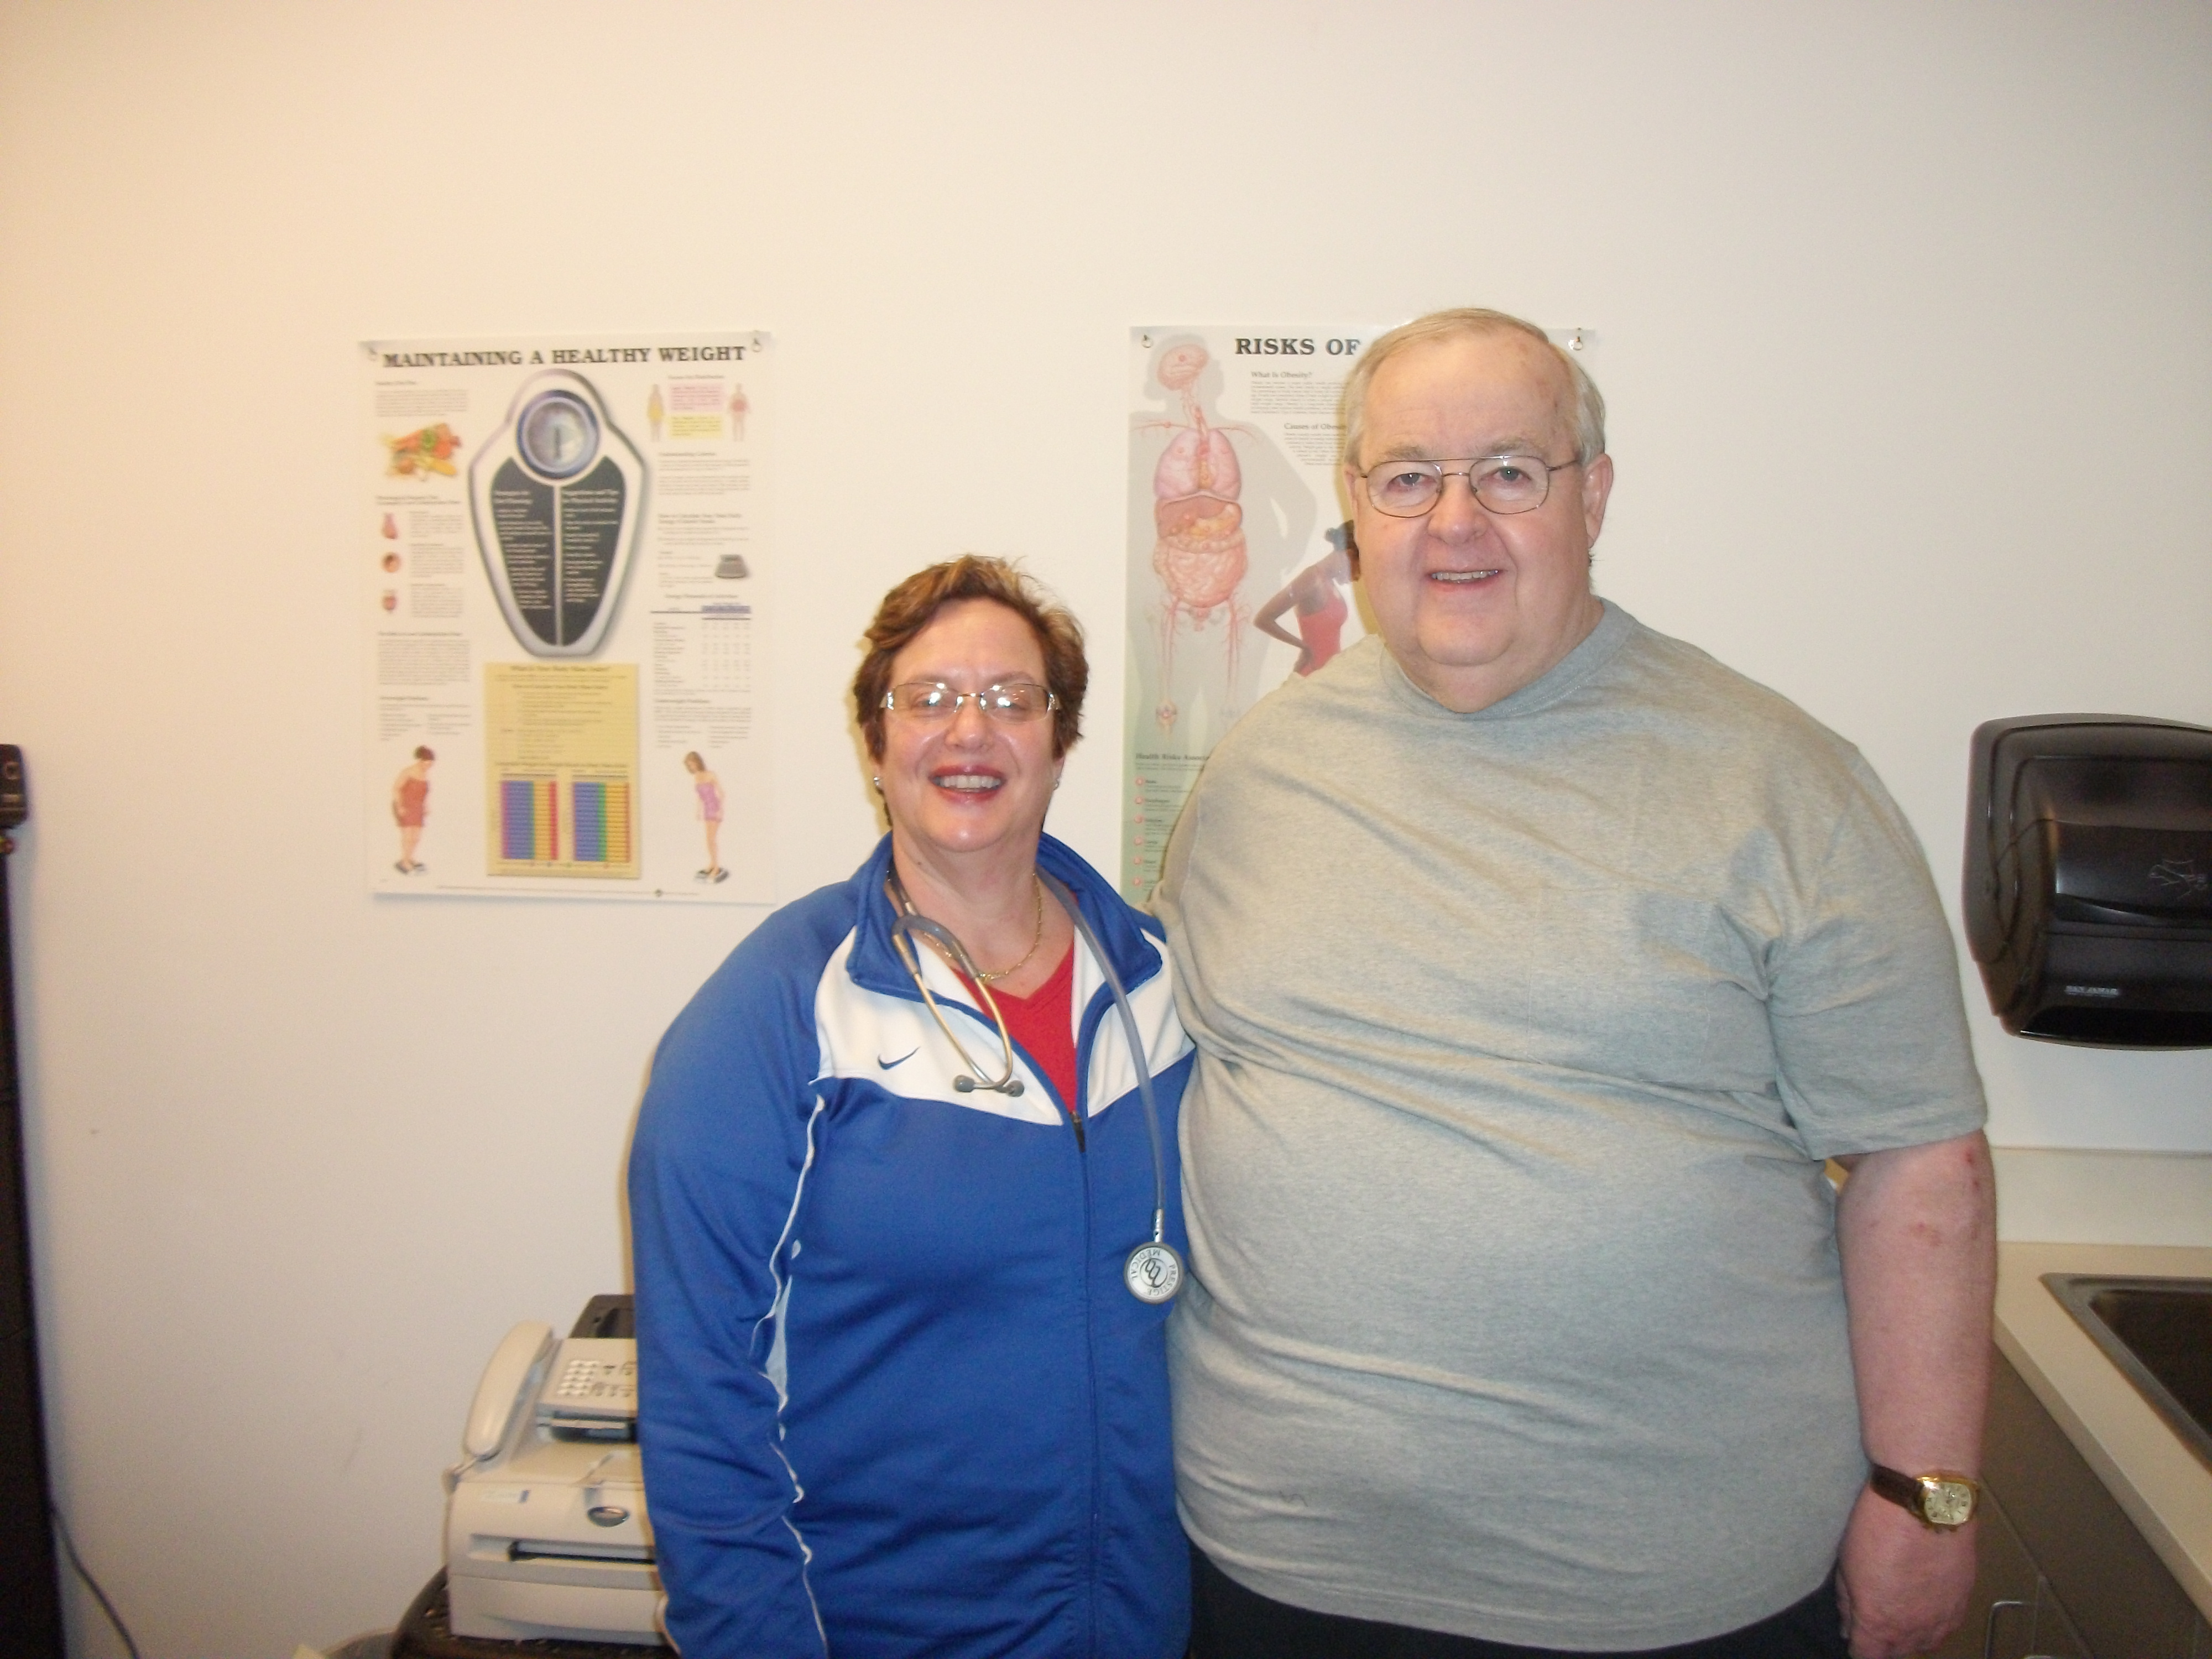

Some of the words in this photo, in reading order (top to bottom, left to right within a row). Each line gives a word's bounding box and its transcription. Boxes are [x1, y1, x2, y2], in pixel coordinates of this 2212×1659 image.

[1235, 338, 1315, 355] RISKS
[1326, 338, 1360, 356] OF
[383, 351, 523, 367] MAINTAINING
[529, 350, 544, 364] A
[552, 348, 651, 363] HEALTHY
[659, 346, 745, 361] WEIGHT
[1280, 371, 1312, 379] Obesity?
